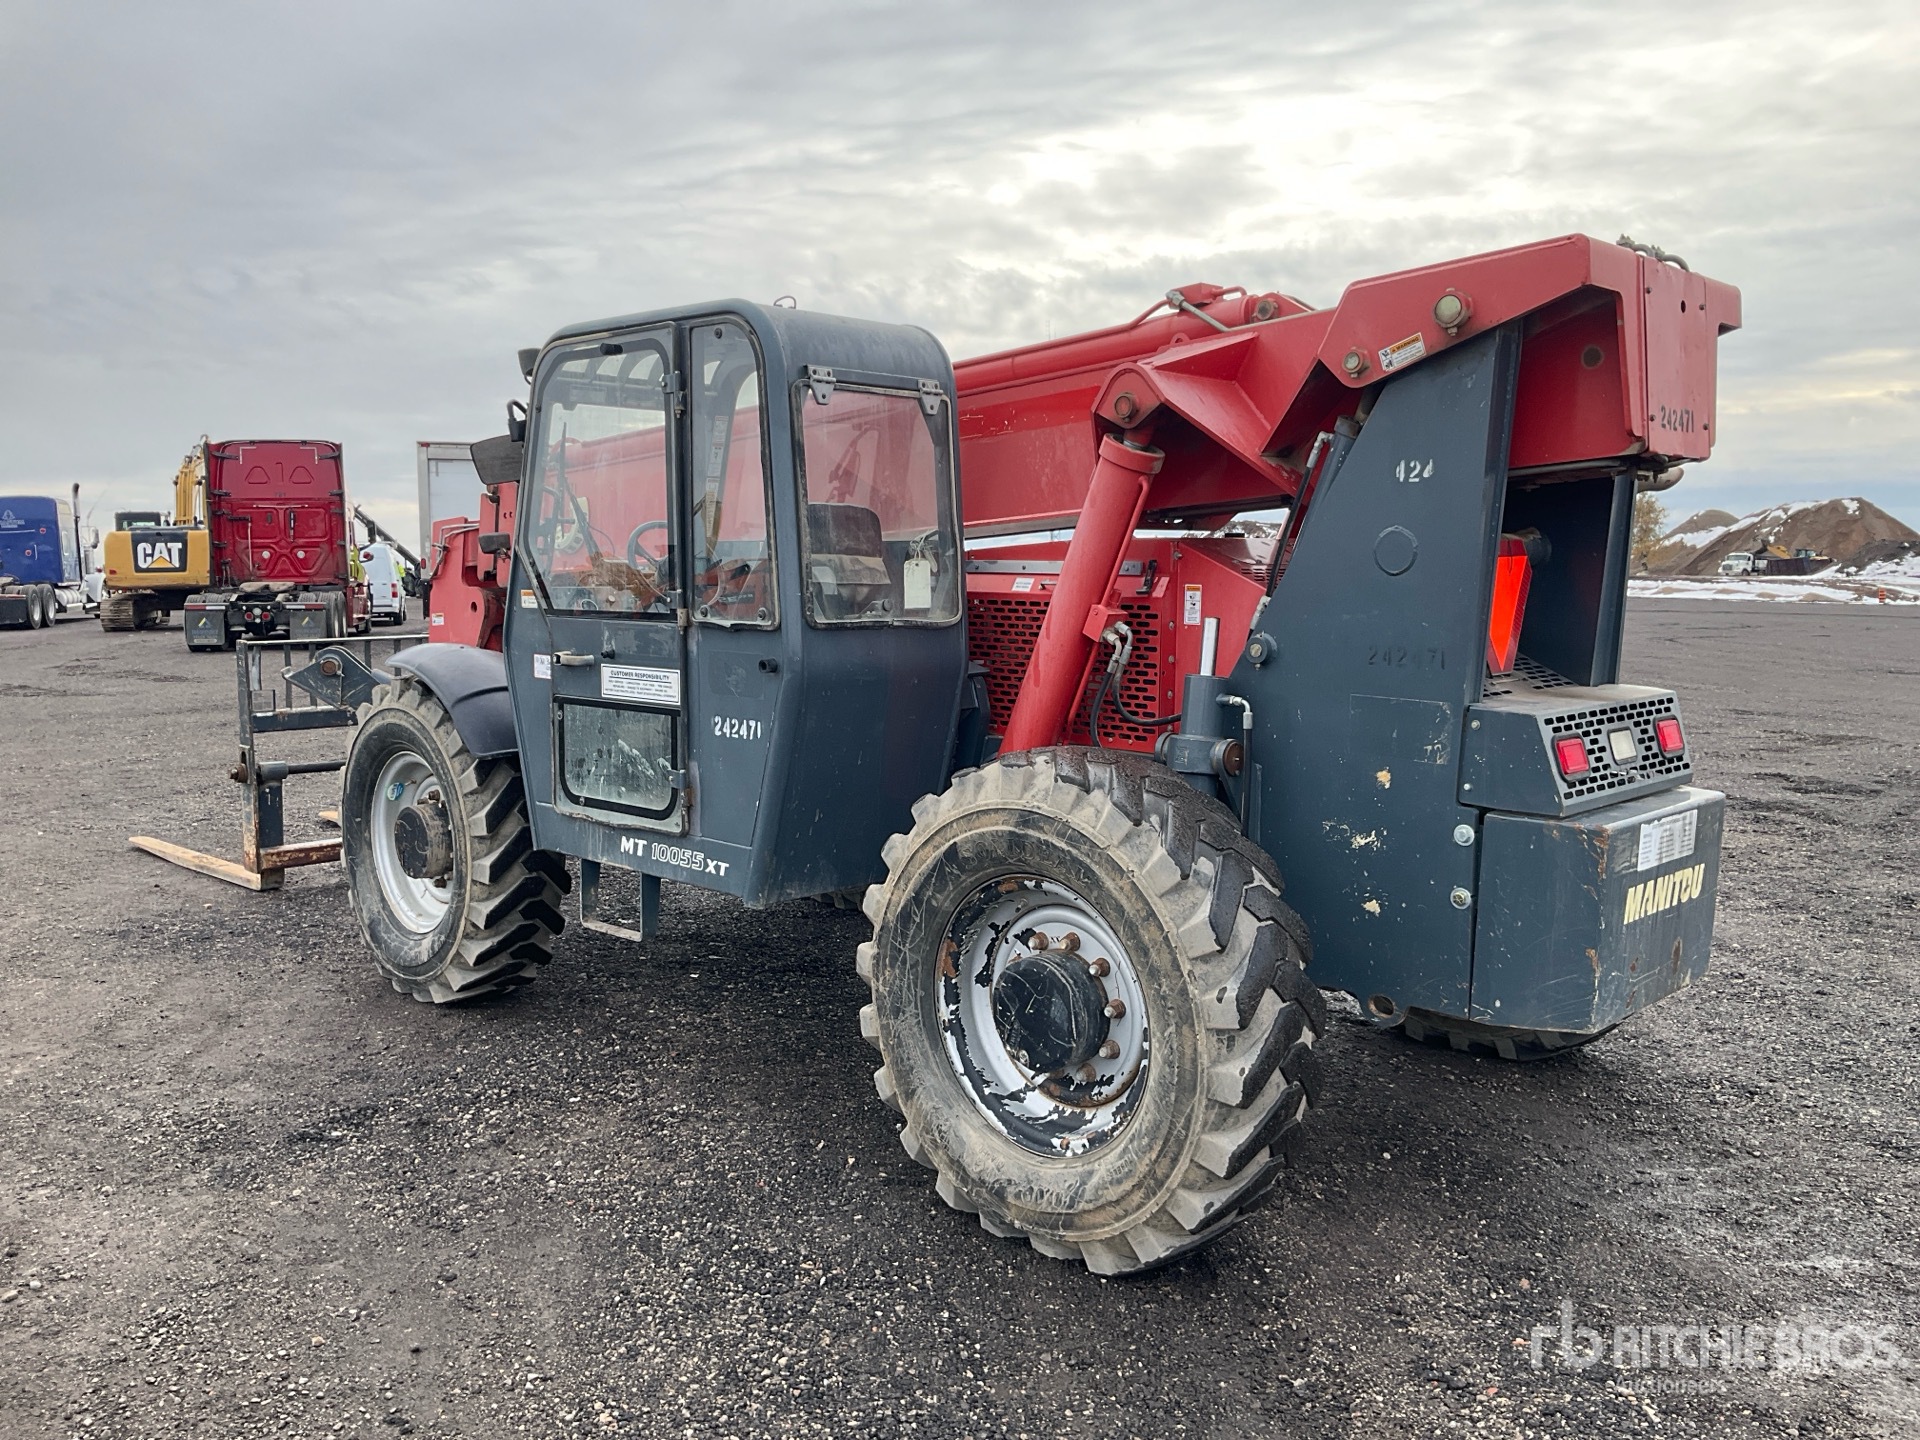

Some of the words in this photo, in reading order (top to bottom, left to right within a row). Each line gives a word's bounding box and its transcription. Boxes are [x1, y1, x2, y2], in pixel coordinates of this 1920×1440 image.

[1661, 405, 1694, 433] 242471
[137, 542, 182, 568] CAT
[1368, 646, 1445, 670] 24271
[610, 670, 634, 678] CUSTOMER
[634, 672, 670, 681] RESPONSIBILITY
[714, 715, 761, 740] 242471
[620, 835, 647, 857] MT
[1624, 863, 1705, 925] MANITOU
